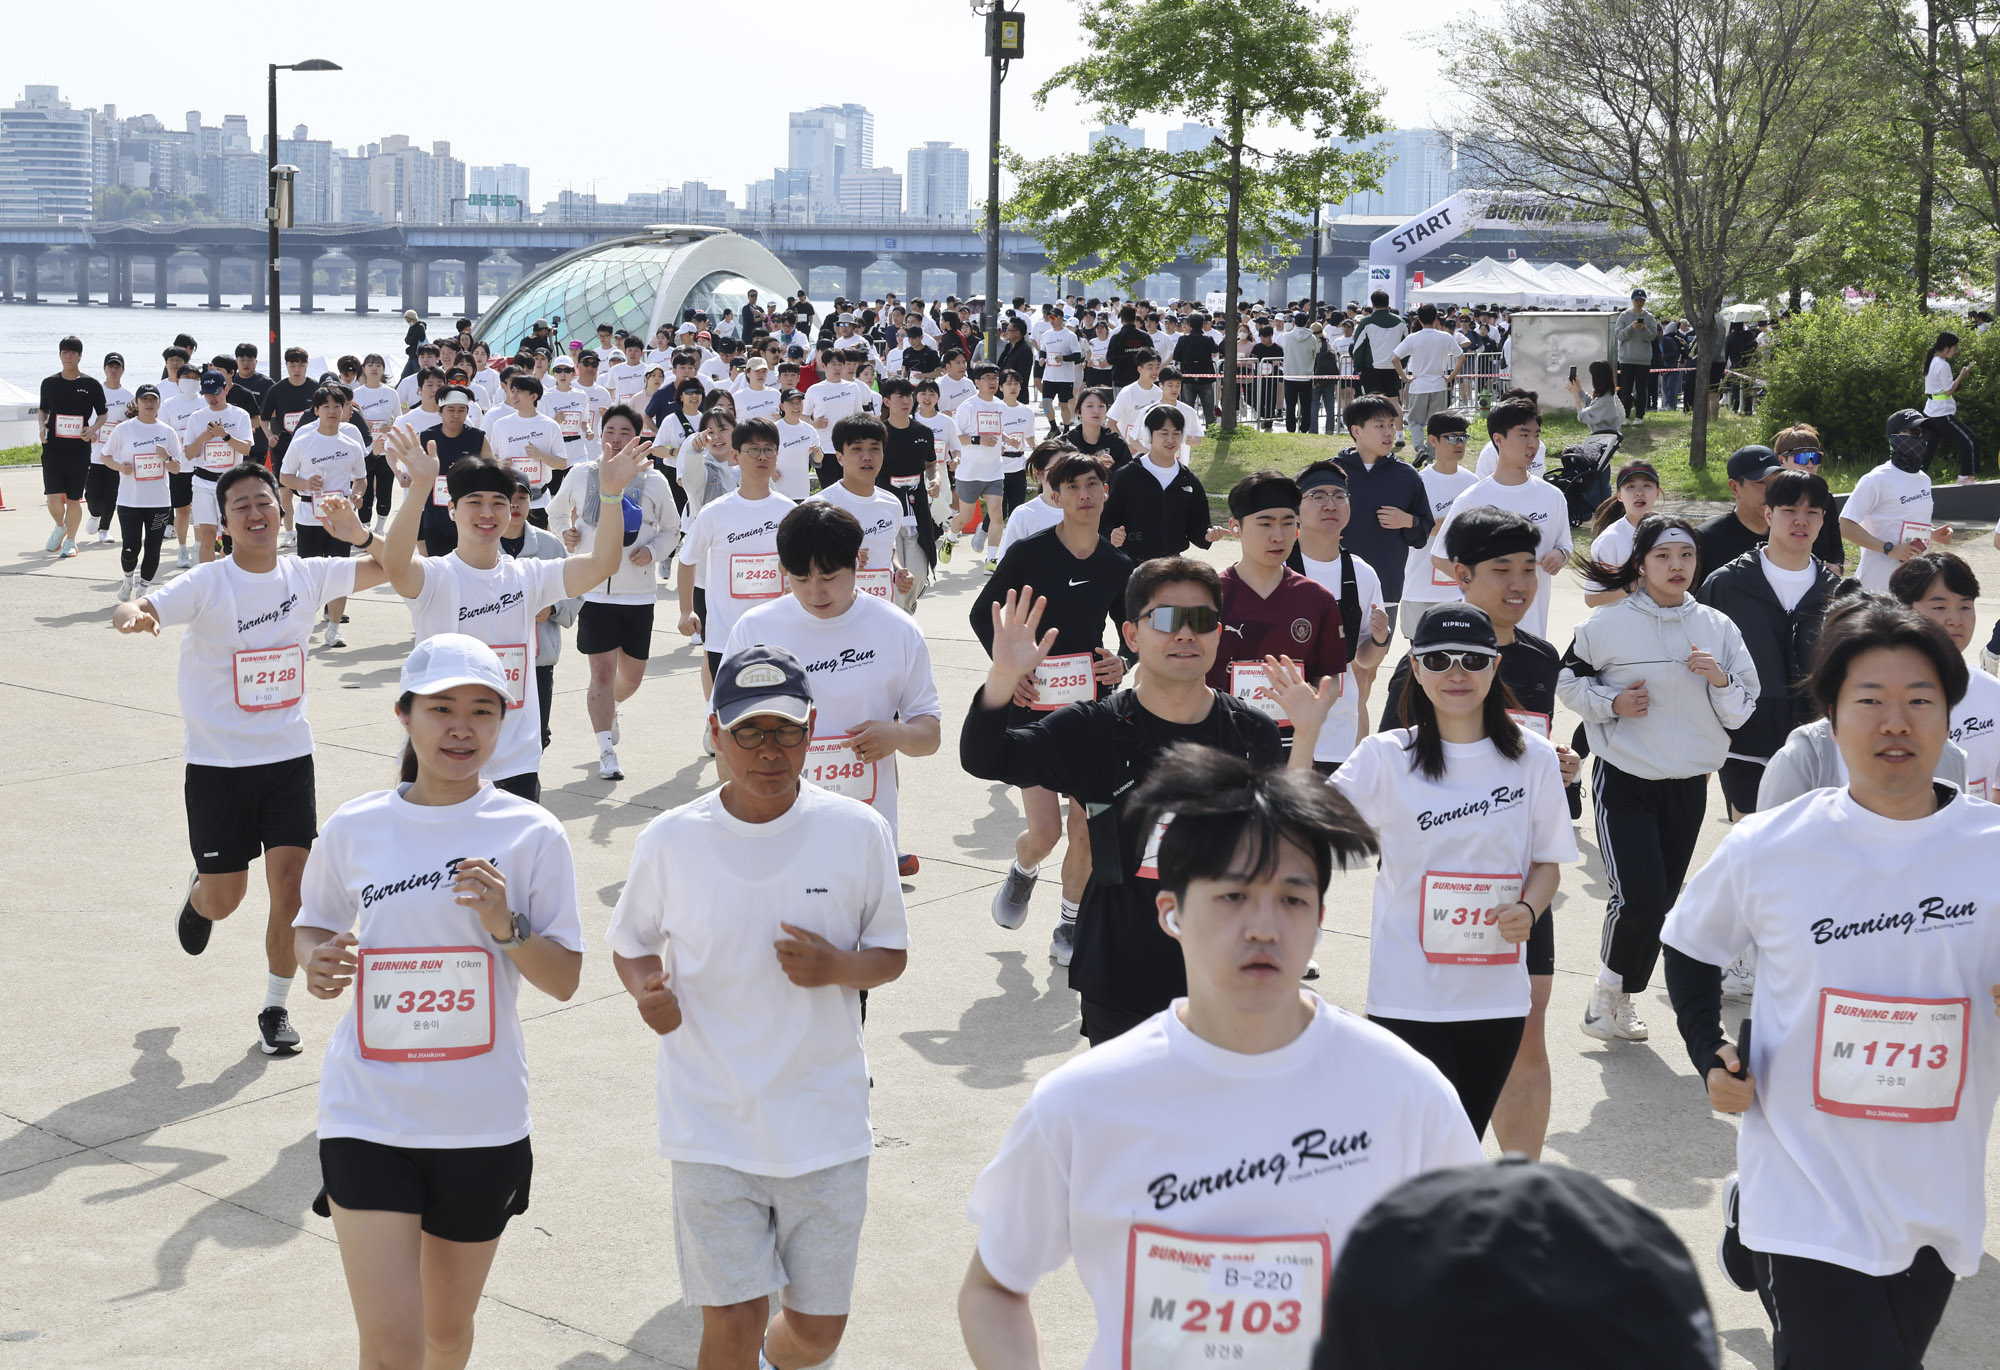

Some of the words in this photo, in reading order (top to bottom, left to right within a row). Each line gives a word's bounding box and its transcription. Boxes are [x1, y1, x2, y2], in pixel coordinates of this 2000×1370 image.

[1392, 208, 1451, 253] START
[311, 455, 335, 465] Burning
[876, 519, 893, 530] Run
[1529, 512, 1548, 524] Run
[727, 527, 764, 543] Burning
[763, 520, 779, 531] Ru
[745, 570, 777, 580] 2426
[458, 601, 501, 621] Burning
[500, 590, 524, 608] Run
[237, 606, 283, 633] Burning
[240, 655, 268, 663] BURNING
[839, 649, 876, 665] Run
[243, 674, 253, 683] M
[256, 667, 297, 684] 2128
[1038, 678, 1047, 686] M
[1049, 674, 1087, 688] 2335
[1240, 688, 1250, 697] M
[1963, 717, 1995, 736] Run
[827, 743, 842, 751] RUN
[813, 762, 865, 781] 1348
[1417, 798, 1491, 831] Burning
[1490, 786, 1526, 810] Run
[361, 869, 444, 909] Burning
[1432, 881, 1472, 892] BURNING
[1473, 883, 1493, 893] RUN
[1433, 908, 1448, 921] W
[1810, 912, 1917, 945] Burning
[1918, 896, 1977, 925] Run
[370, 961, 419, 972] BURNING
[420, 959, 444, 970] RUN
[455, 960, 482, 969] 10km
[373, 994, 392, 1010] W
[396, 989, 476, 1014] 3235
[1833, 1004, 1890, 1020] BURNING
[1891, 1010, 1918, 1021] RUN
[1930, 1012, 1957, 1022] 10km
[413, 1020, 440, 1031] 윤송이
[1833, 1041, 1855, 1059] M
[1863, 1041, 1949, 1070] 1713
[1147, 1153, 1289, 1211] Burning
[1292, 1128, 1372, 1169] Run
[1148, 1244, 1216, 1268] BURNING
[1224, 1267, 1293, 1291] B-220
[1150, 1296, 1176, 1322] M
[1181, 1298, 1302, 1335] 2103
